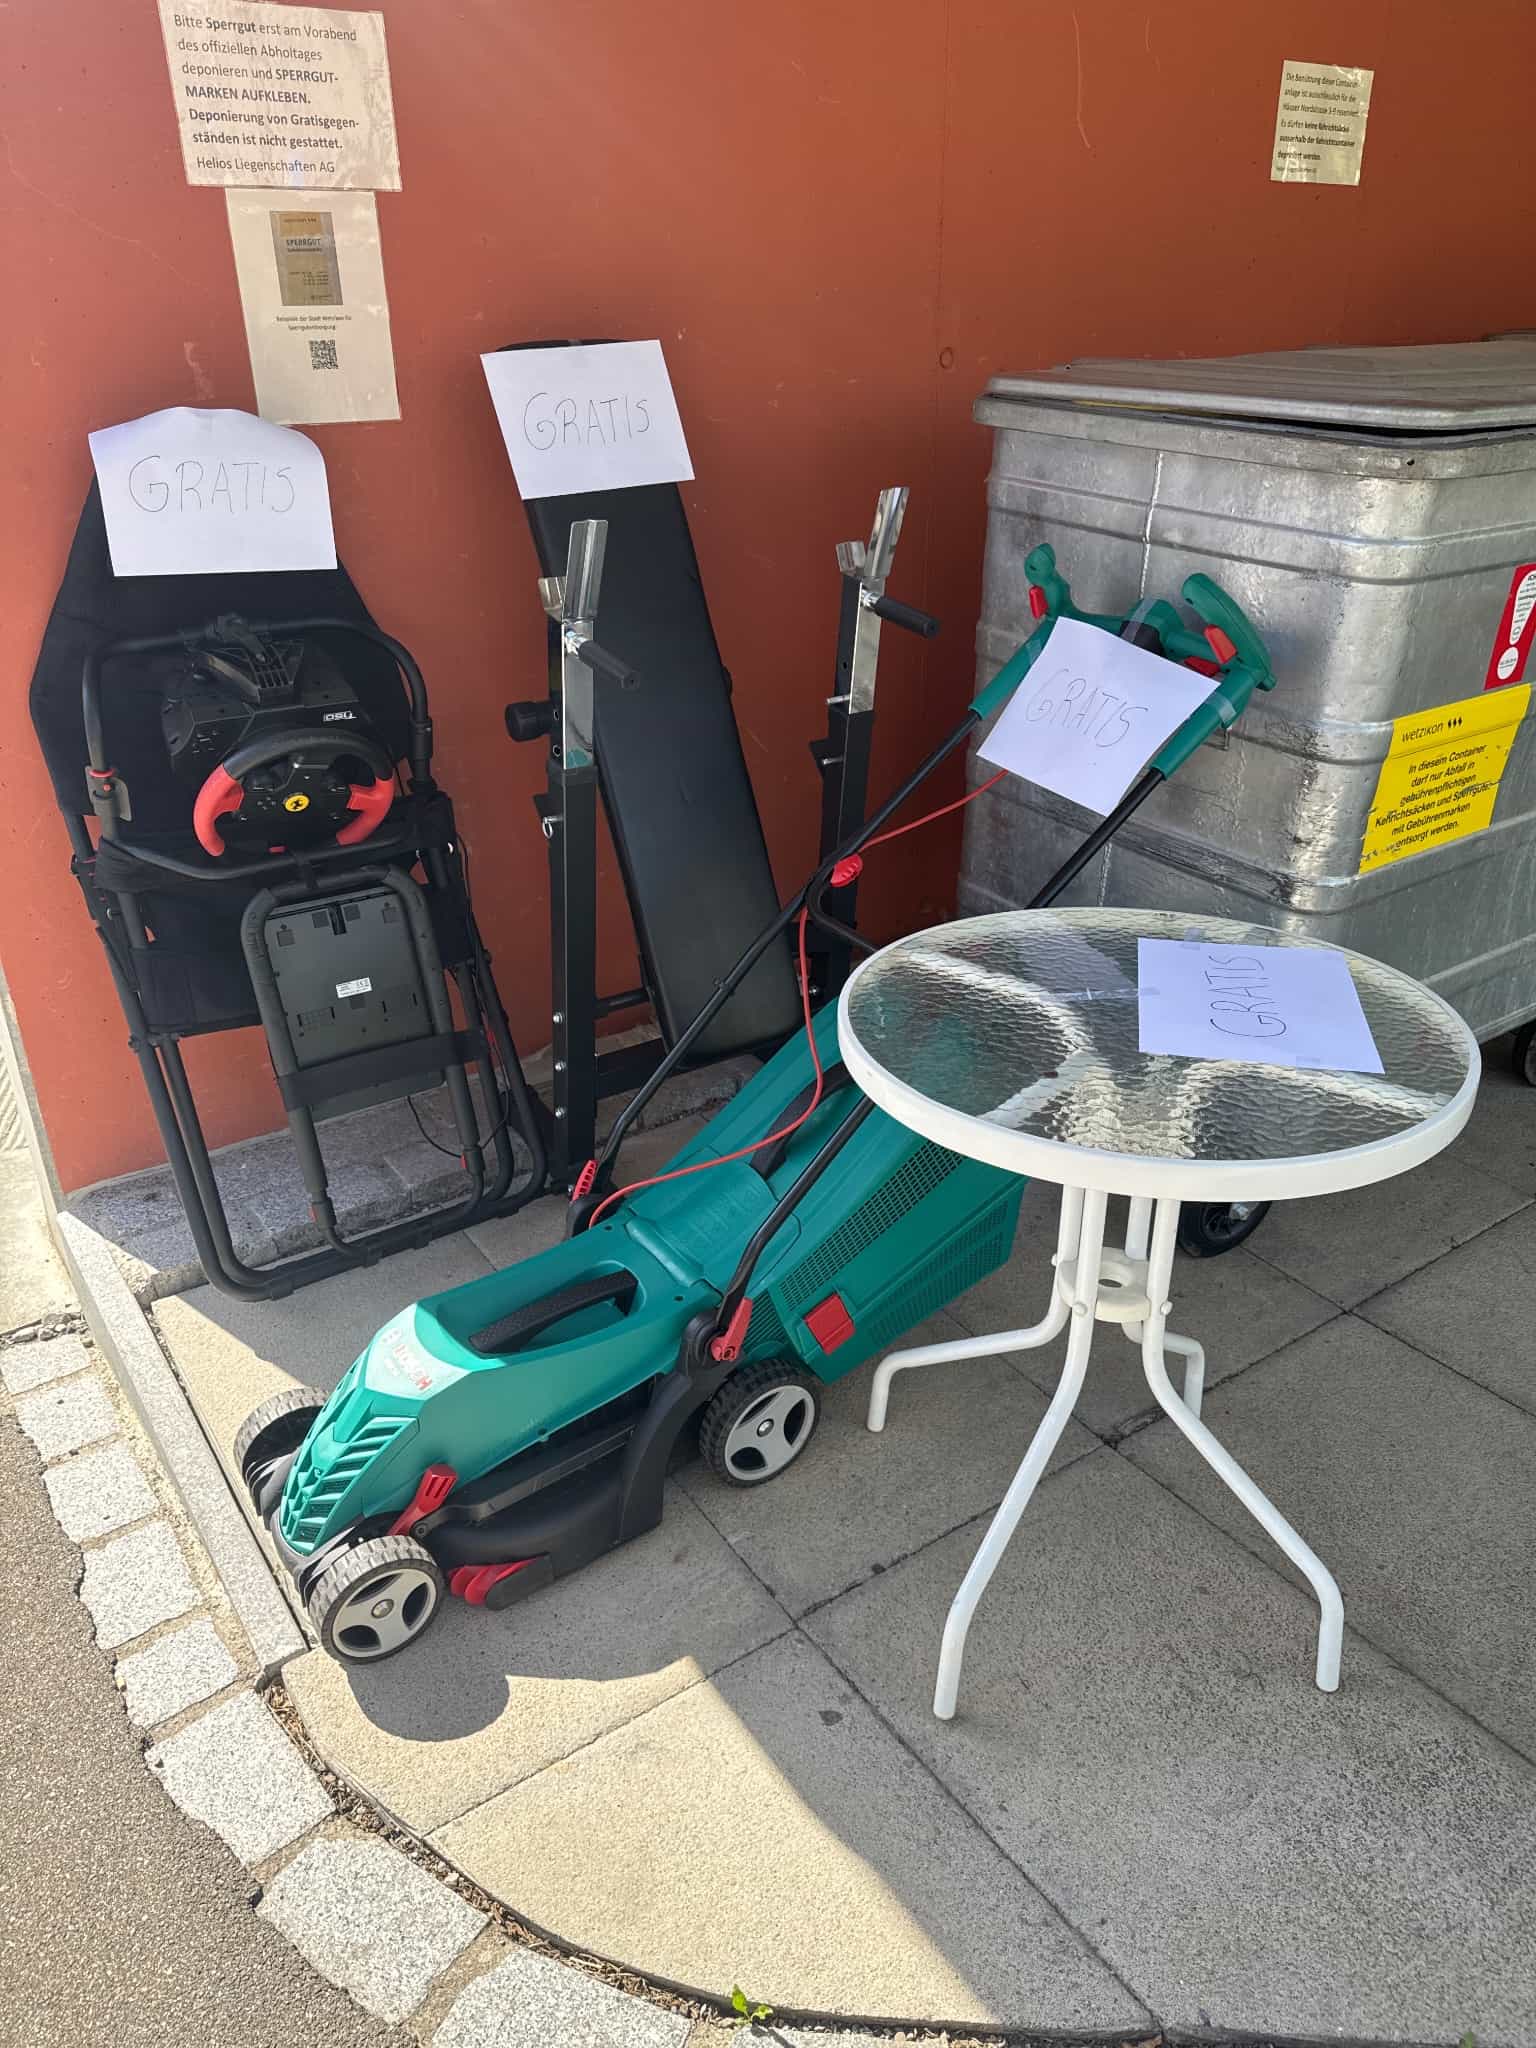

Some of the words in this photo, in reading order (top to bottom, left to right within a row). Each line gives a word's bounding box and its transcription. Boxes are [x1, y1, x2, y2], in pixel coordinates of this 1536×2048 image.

[174, 14, 203, 29] Bitte
[205, 17, 256, 36] Sperrgut
[258, 22, 281, 35] erst
[283, 26, 301, 37] am
[303, 24, 357, 41] Vorabend
[177, 38, 199, 52] des
[202, 40, 257, 56] offiziellen
[260, 45, 322, 62] Abholtages
[182, 62, 249, 80] deponieren
[251, 66, 273, 80] und
[275, 69, 339, 83] SPERRGUT-
[185, 85, 239, 100] MARKEN
[241, 89, 311, 104] AUFKLEBEN.
[189, 108, 265, 127] Deponierung
[267, 114, 288, 125] von
[290, 114, 360, 130] Gratisgegen-
[193, 131, 240, 146] ständen
[242, 133, 257, 146] ist
[259, 134, 287, 147] nicht
[289, 137, 343, 152] gestattet.
[196, 156, 233, 170] Helios
[235, 157, 316, 174] Liegenschaften
[319, 161, 336, 173] AG
[524, 392, 651, 451] GRATIS
[128, 455, 296, 514] GRATIS
[1025, 668, 1149, 748] GRATIS
[1402, 722, 1443, 742] wetzikon
[1408, 763, 1417, 775] In
[1418, 756, 1448, 771] diesem
[1448, 744, 1488, 762] Container
[1411, 773, 1430, 788] darf
[1429, 771, 1444, 782] nur
[1443, 763, 1467, 778] Abfall
[1466, 761, 1476, 770] in
[1436, 795, 1453, 807] und
[1391, 823, 1405, 836] mit
[1406, 802, 1471, 831] Gebührenmarken
[1205, 955, 1287, 1038] GRATIS
